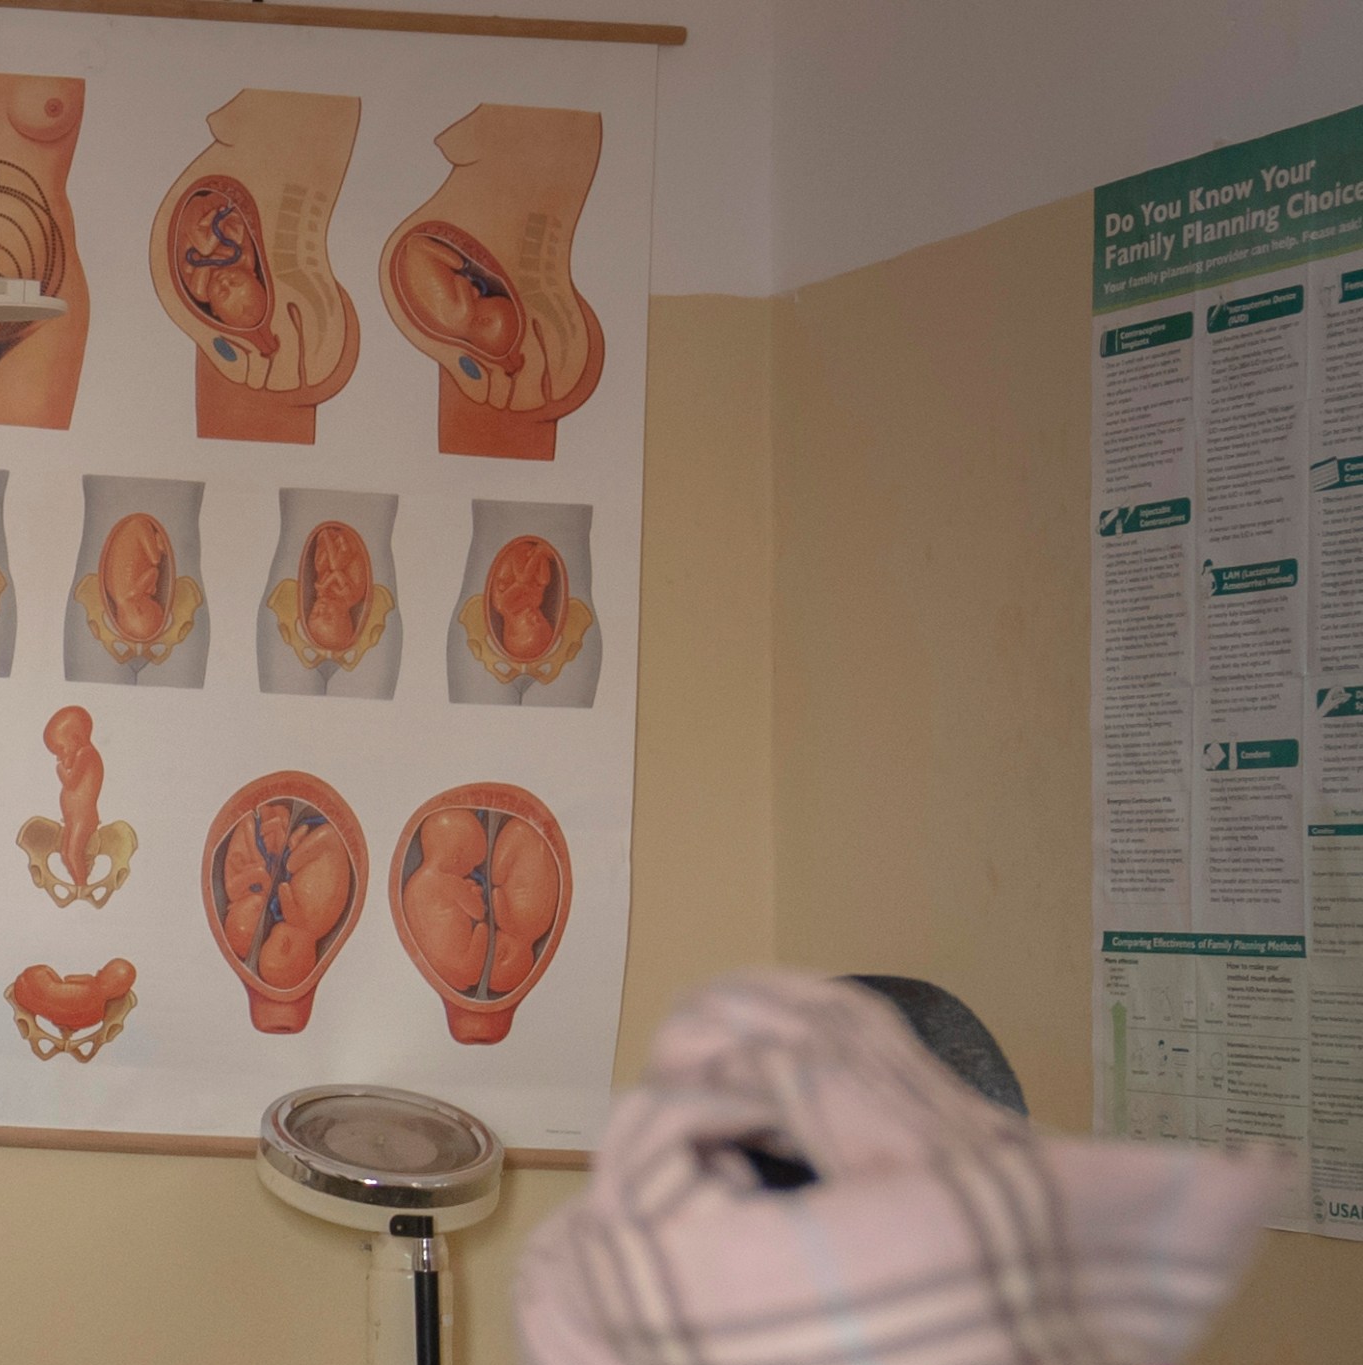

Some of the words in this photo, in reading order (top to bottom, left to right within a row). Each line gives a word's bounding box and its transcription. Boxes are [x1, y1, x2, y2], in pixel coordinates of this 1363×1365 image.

[1105, 213, 1135, 238] Do
[1141, 200, 1182, 226] You
[1188, 178, 1254, 214] Know
[1260, 159, 1317, 192] Your
[1103, 281, 1127, 295] Your
[1128, 271, 1159, 288] family
[1160, 261, 1204, 283] planning
[1206, 248, 1250, 271] provider
[1250, 244, 1270, 256] can
[1271, 235, 1299, 252] help.
[1302, 226, 1336, 243] Pease
[1105, 231, 1176, 270] Family
[1182, 204, 1281, 250] Planning
[1222, 570, 1240, 580] LAM
[1112, 936, 1151, 950] Comparing
[1153, 936, 1196, 949] Effectiveness
[1198, 938, 1208, 949] of
[1207, 939, 1232, 953] Family
[1233, 940, 1266, 954] Planning
[1267, 941, 1303, 953] Methods
